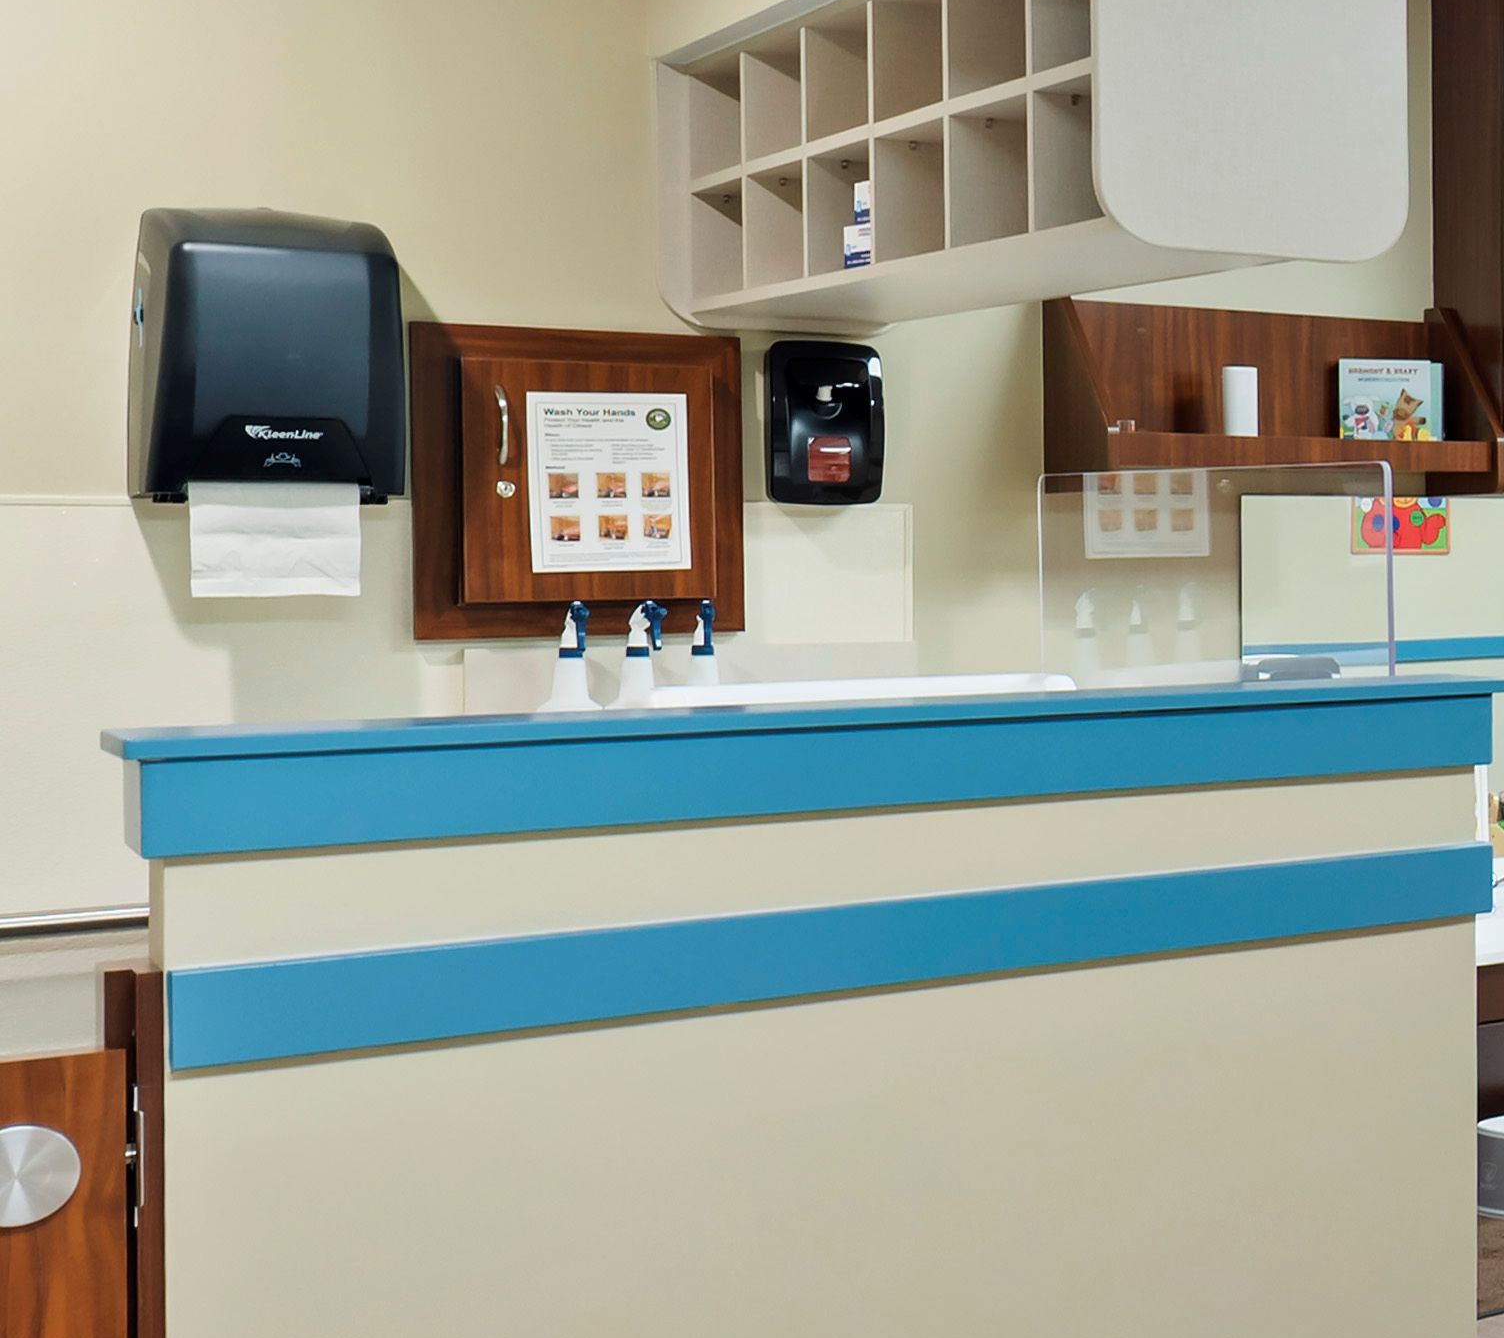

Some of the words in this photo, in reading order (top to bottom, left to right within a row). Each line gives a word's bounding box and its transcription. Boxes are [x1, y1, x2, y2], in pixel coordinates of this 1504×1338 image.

[543, 408, 573, 416] Wash
[576, 408, 600, 417] Your
[603, 408, 636, 417] Hands
